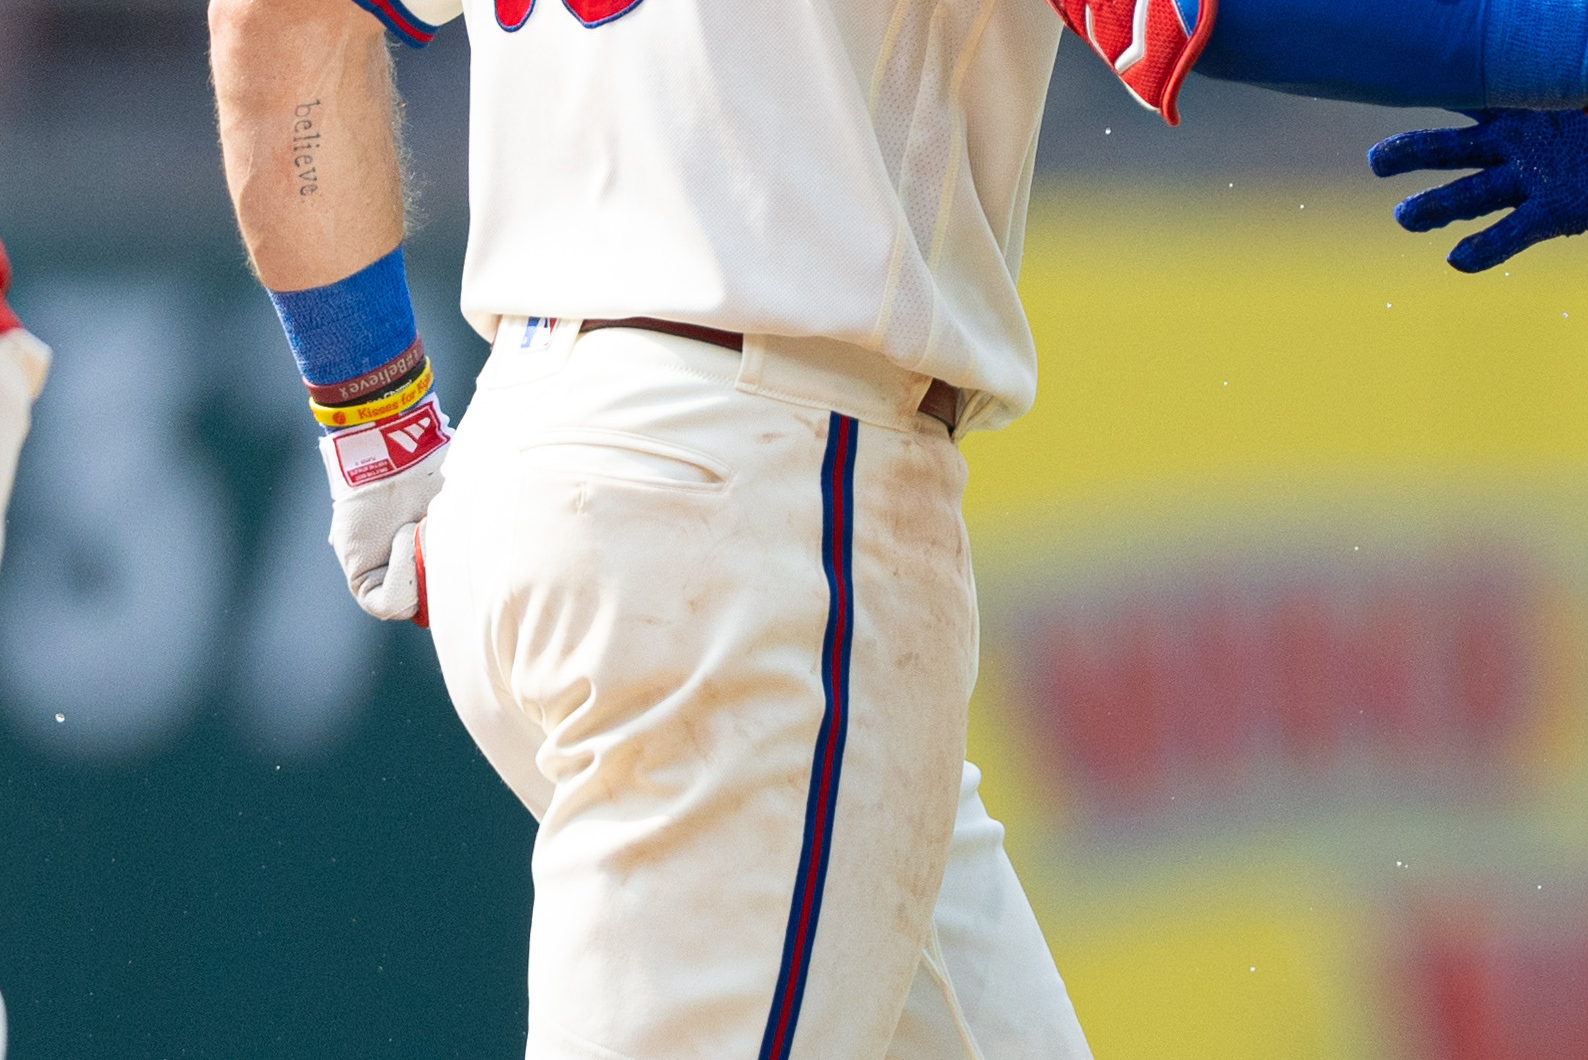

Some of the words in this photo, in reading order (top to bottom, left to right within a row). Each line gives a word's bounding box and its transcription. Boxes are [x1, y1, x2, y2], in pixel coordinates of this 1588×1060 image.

[293, 98, 321, 197] believe
[357, 398, 399, 420] Kisses
[401, 390, 416, 406] for
